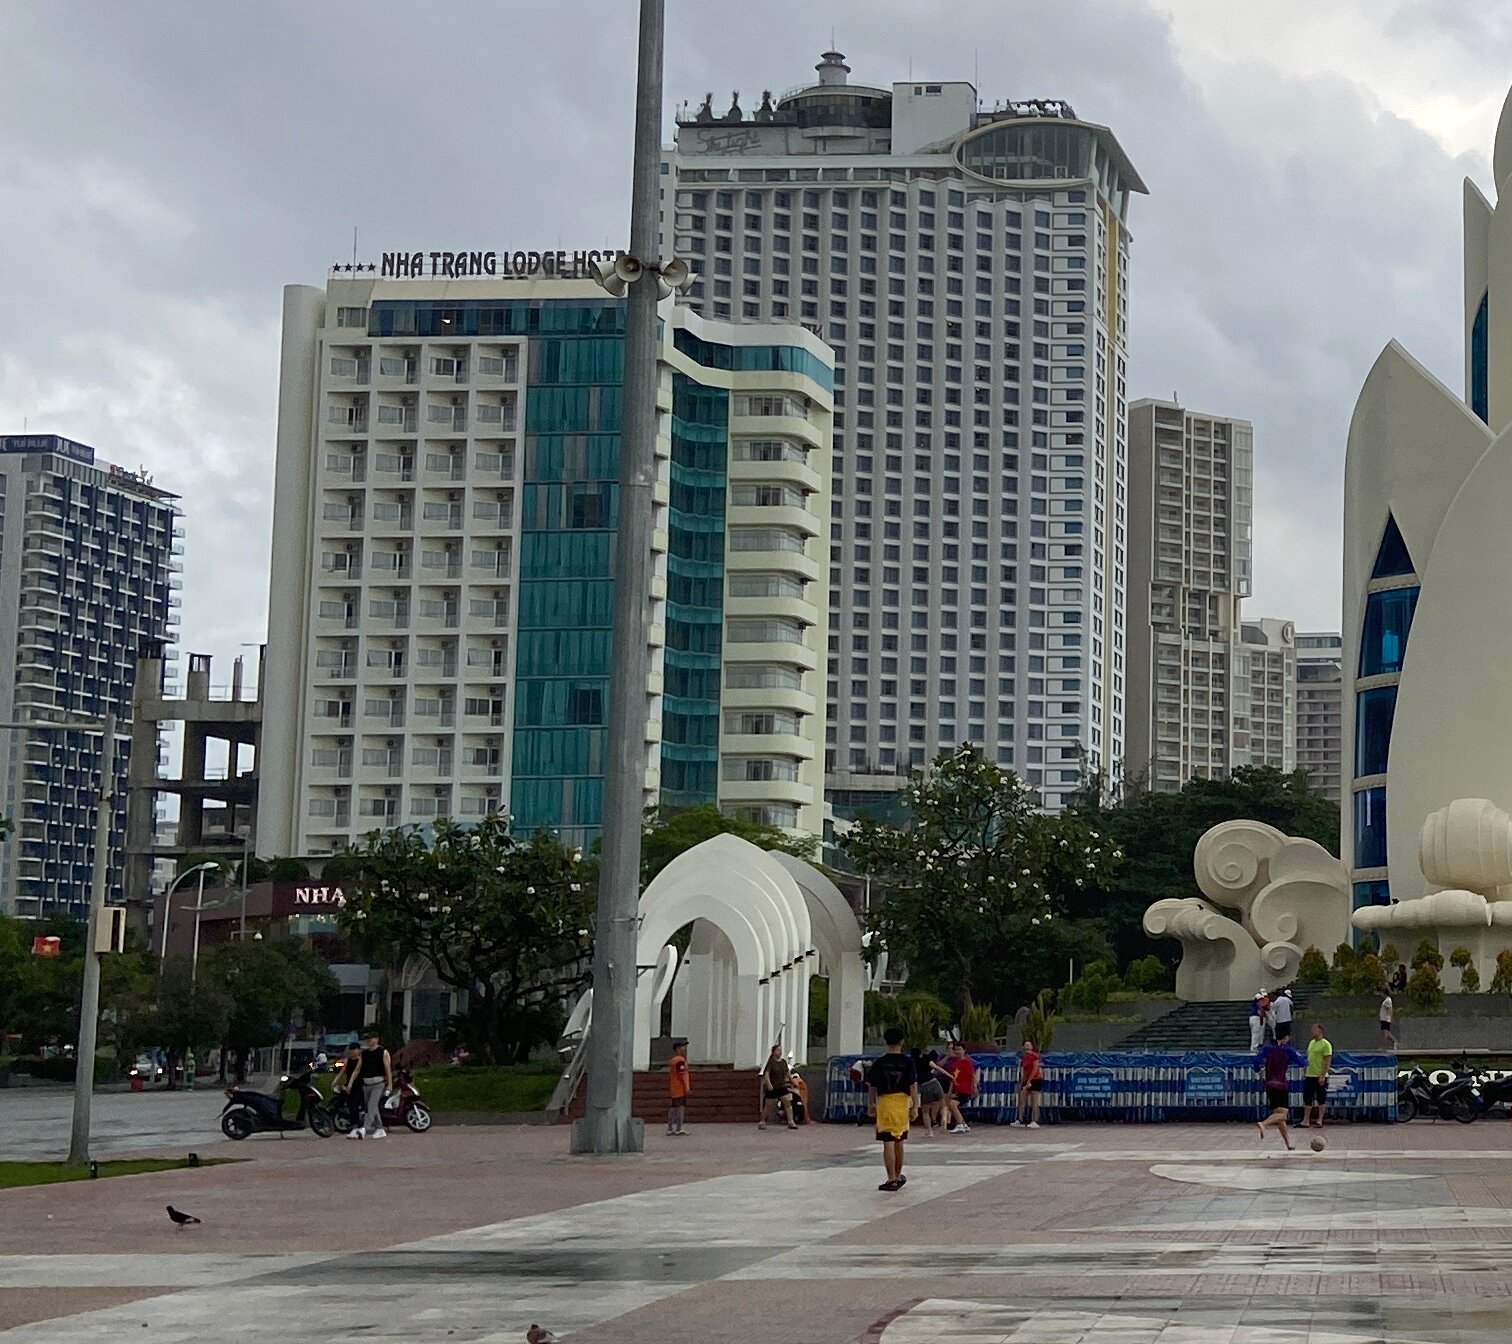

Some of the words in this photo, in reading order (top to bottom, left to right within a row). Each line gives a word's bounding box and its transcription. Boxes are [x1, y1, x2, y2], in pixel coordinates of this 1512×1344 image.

[381, 251, 424, 279] NHA
[429, 251, 497, 279] TRANG
[503, 250, 567, 277] LODGE
[294, 887, 346, 904] NHA
